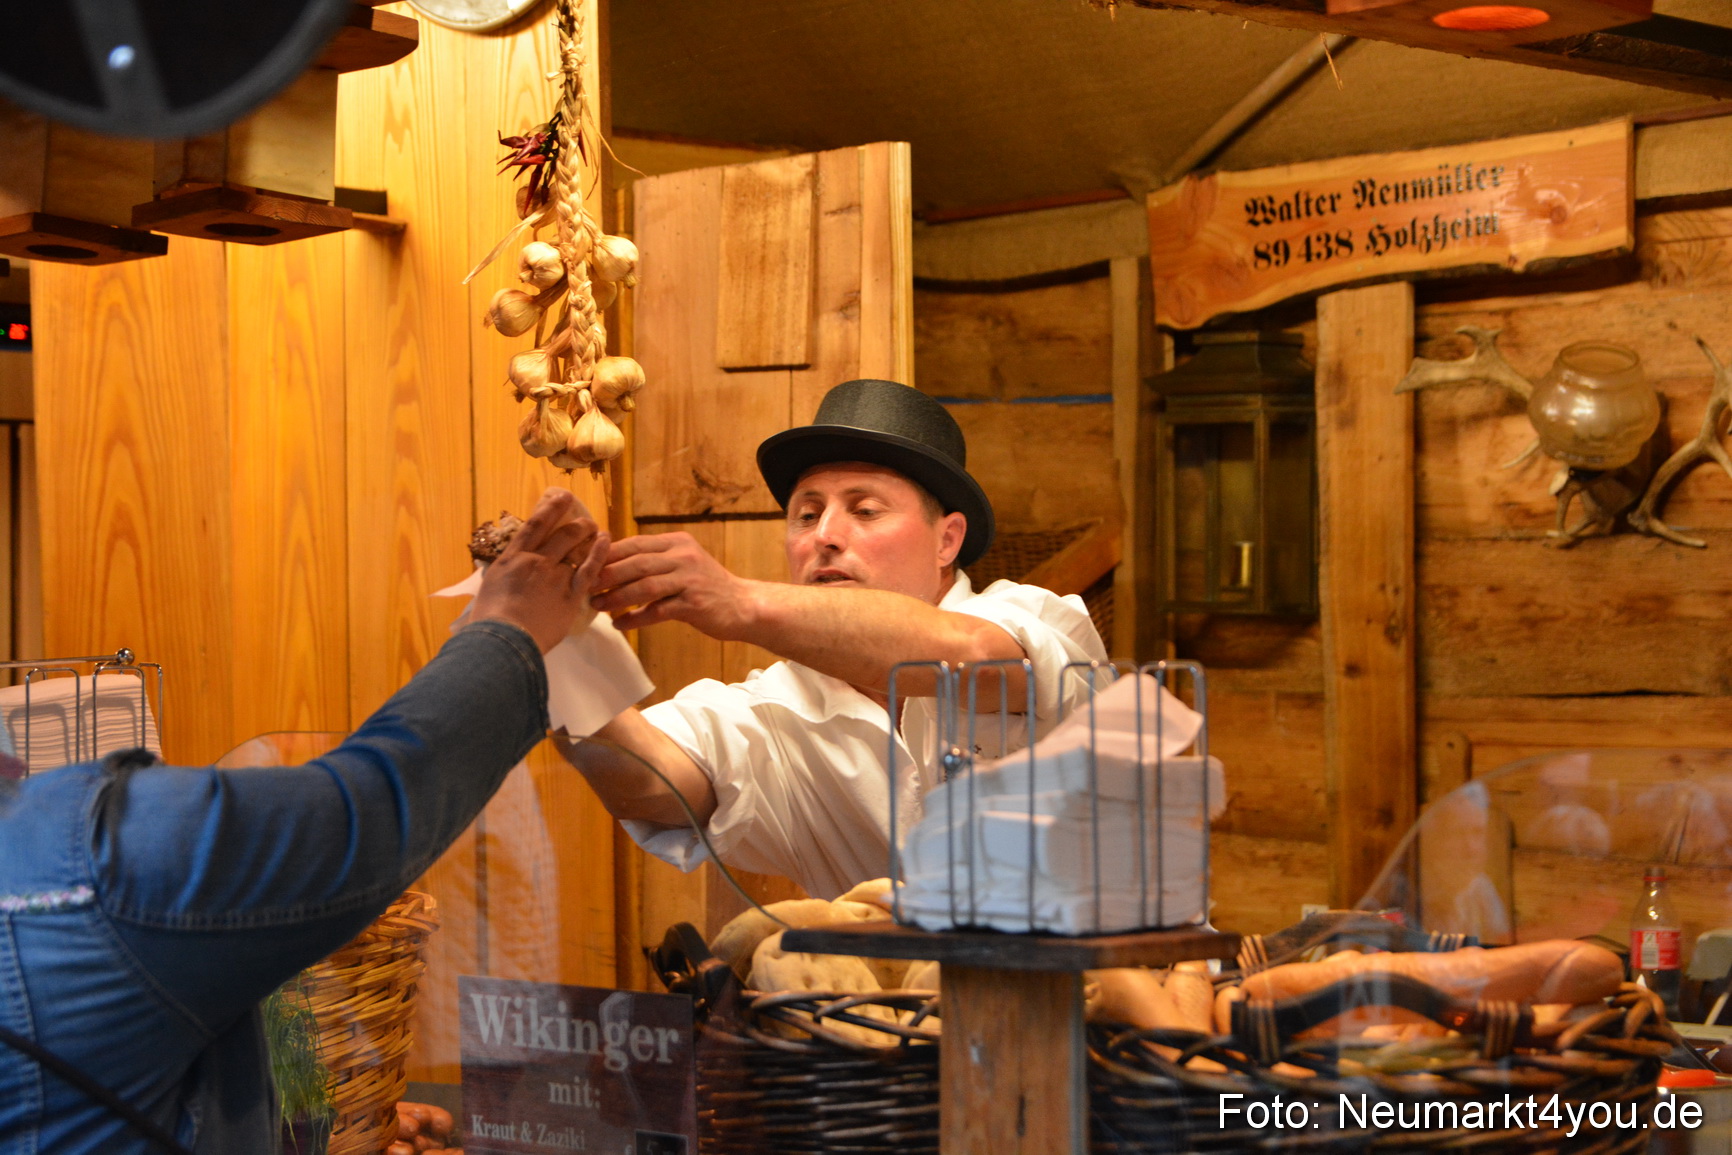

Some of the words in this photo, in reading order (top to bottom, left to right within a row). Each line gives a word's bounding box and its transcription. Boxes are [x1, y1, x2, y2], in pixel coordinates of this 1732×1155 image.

[1244, 190, 1342, 227] Walter
[1352, 163, 1504, 209] Neumüller
[1366, 207, 1499, 256] Holzheim
[470, 993, 680, 1072] Wikinger
[548, 1075, 601, 1109] mit:
[471, 1114, 516, 1140] Kraut
[519, 1120, 533, 1144] &
[537, 1122, 586, 1151] Zaziki
